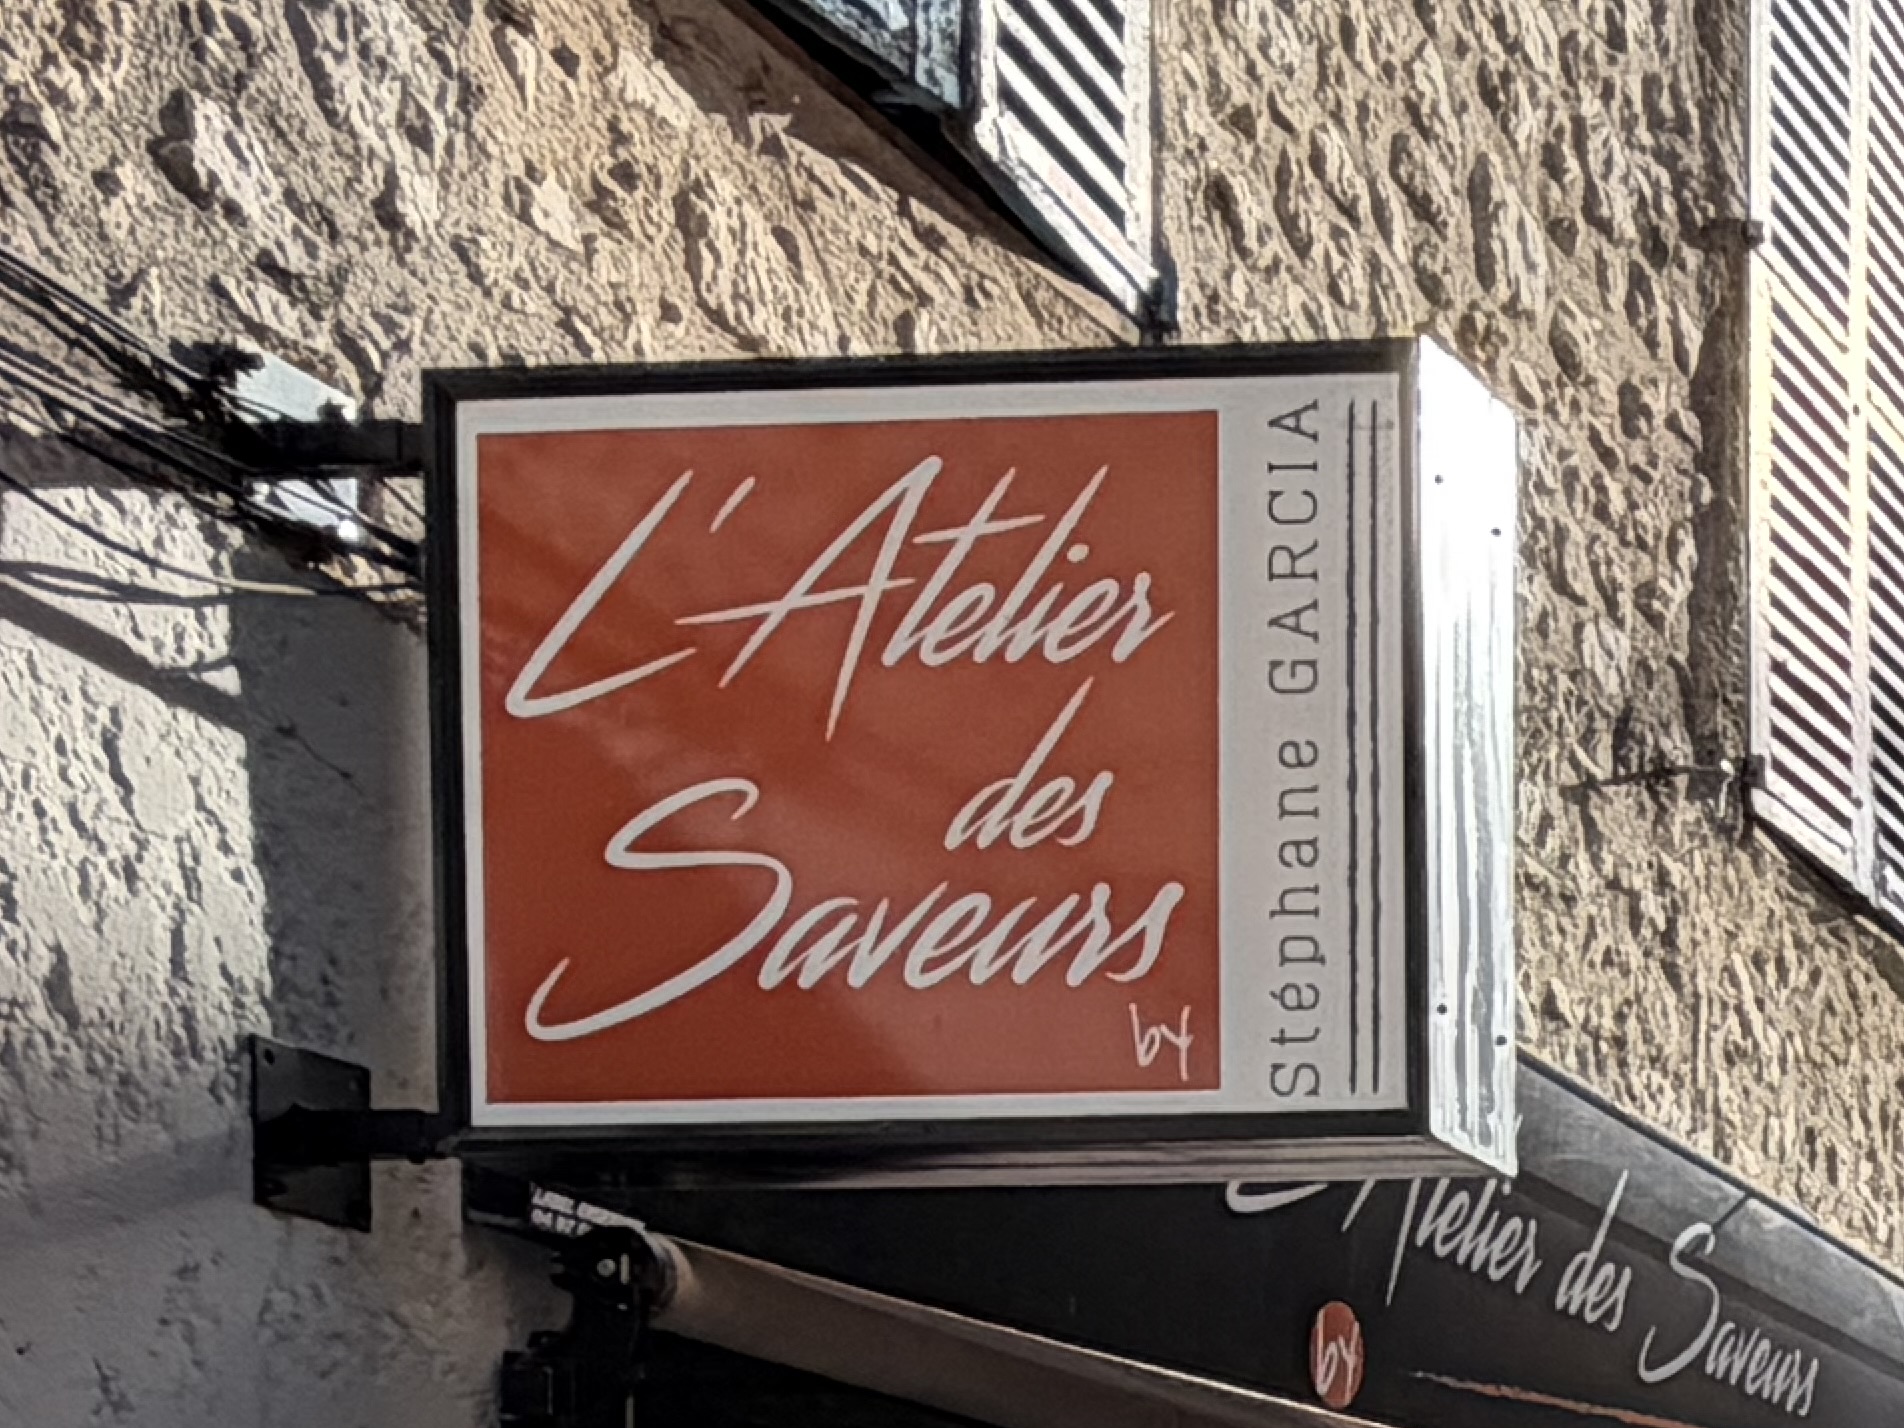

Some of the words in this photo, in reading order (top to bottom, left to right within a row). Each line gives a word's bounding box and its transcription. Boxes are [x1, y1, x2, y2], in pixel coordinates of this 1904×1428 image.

[505, 455, 1175, 741] L'Atelier
[1267, 398, 1321, 694] GARCIA
[943, 677, 1114, 851] des
[524, 778, 1185, 1042] Saveurs
[1268, 740, 1326, 1098] Stéphane
[1128, 1002, 1195, 1082] by
[1226, 1177, 1543, 1306] telier
[1554, 1168, 1632, 1332] des
[1638, 1221, 1820, 1417] Saveurs
[1316, 1307, 1362, 1406] by
